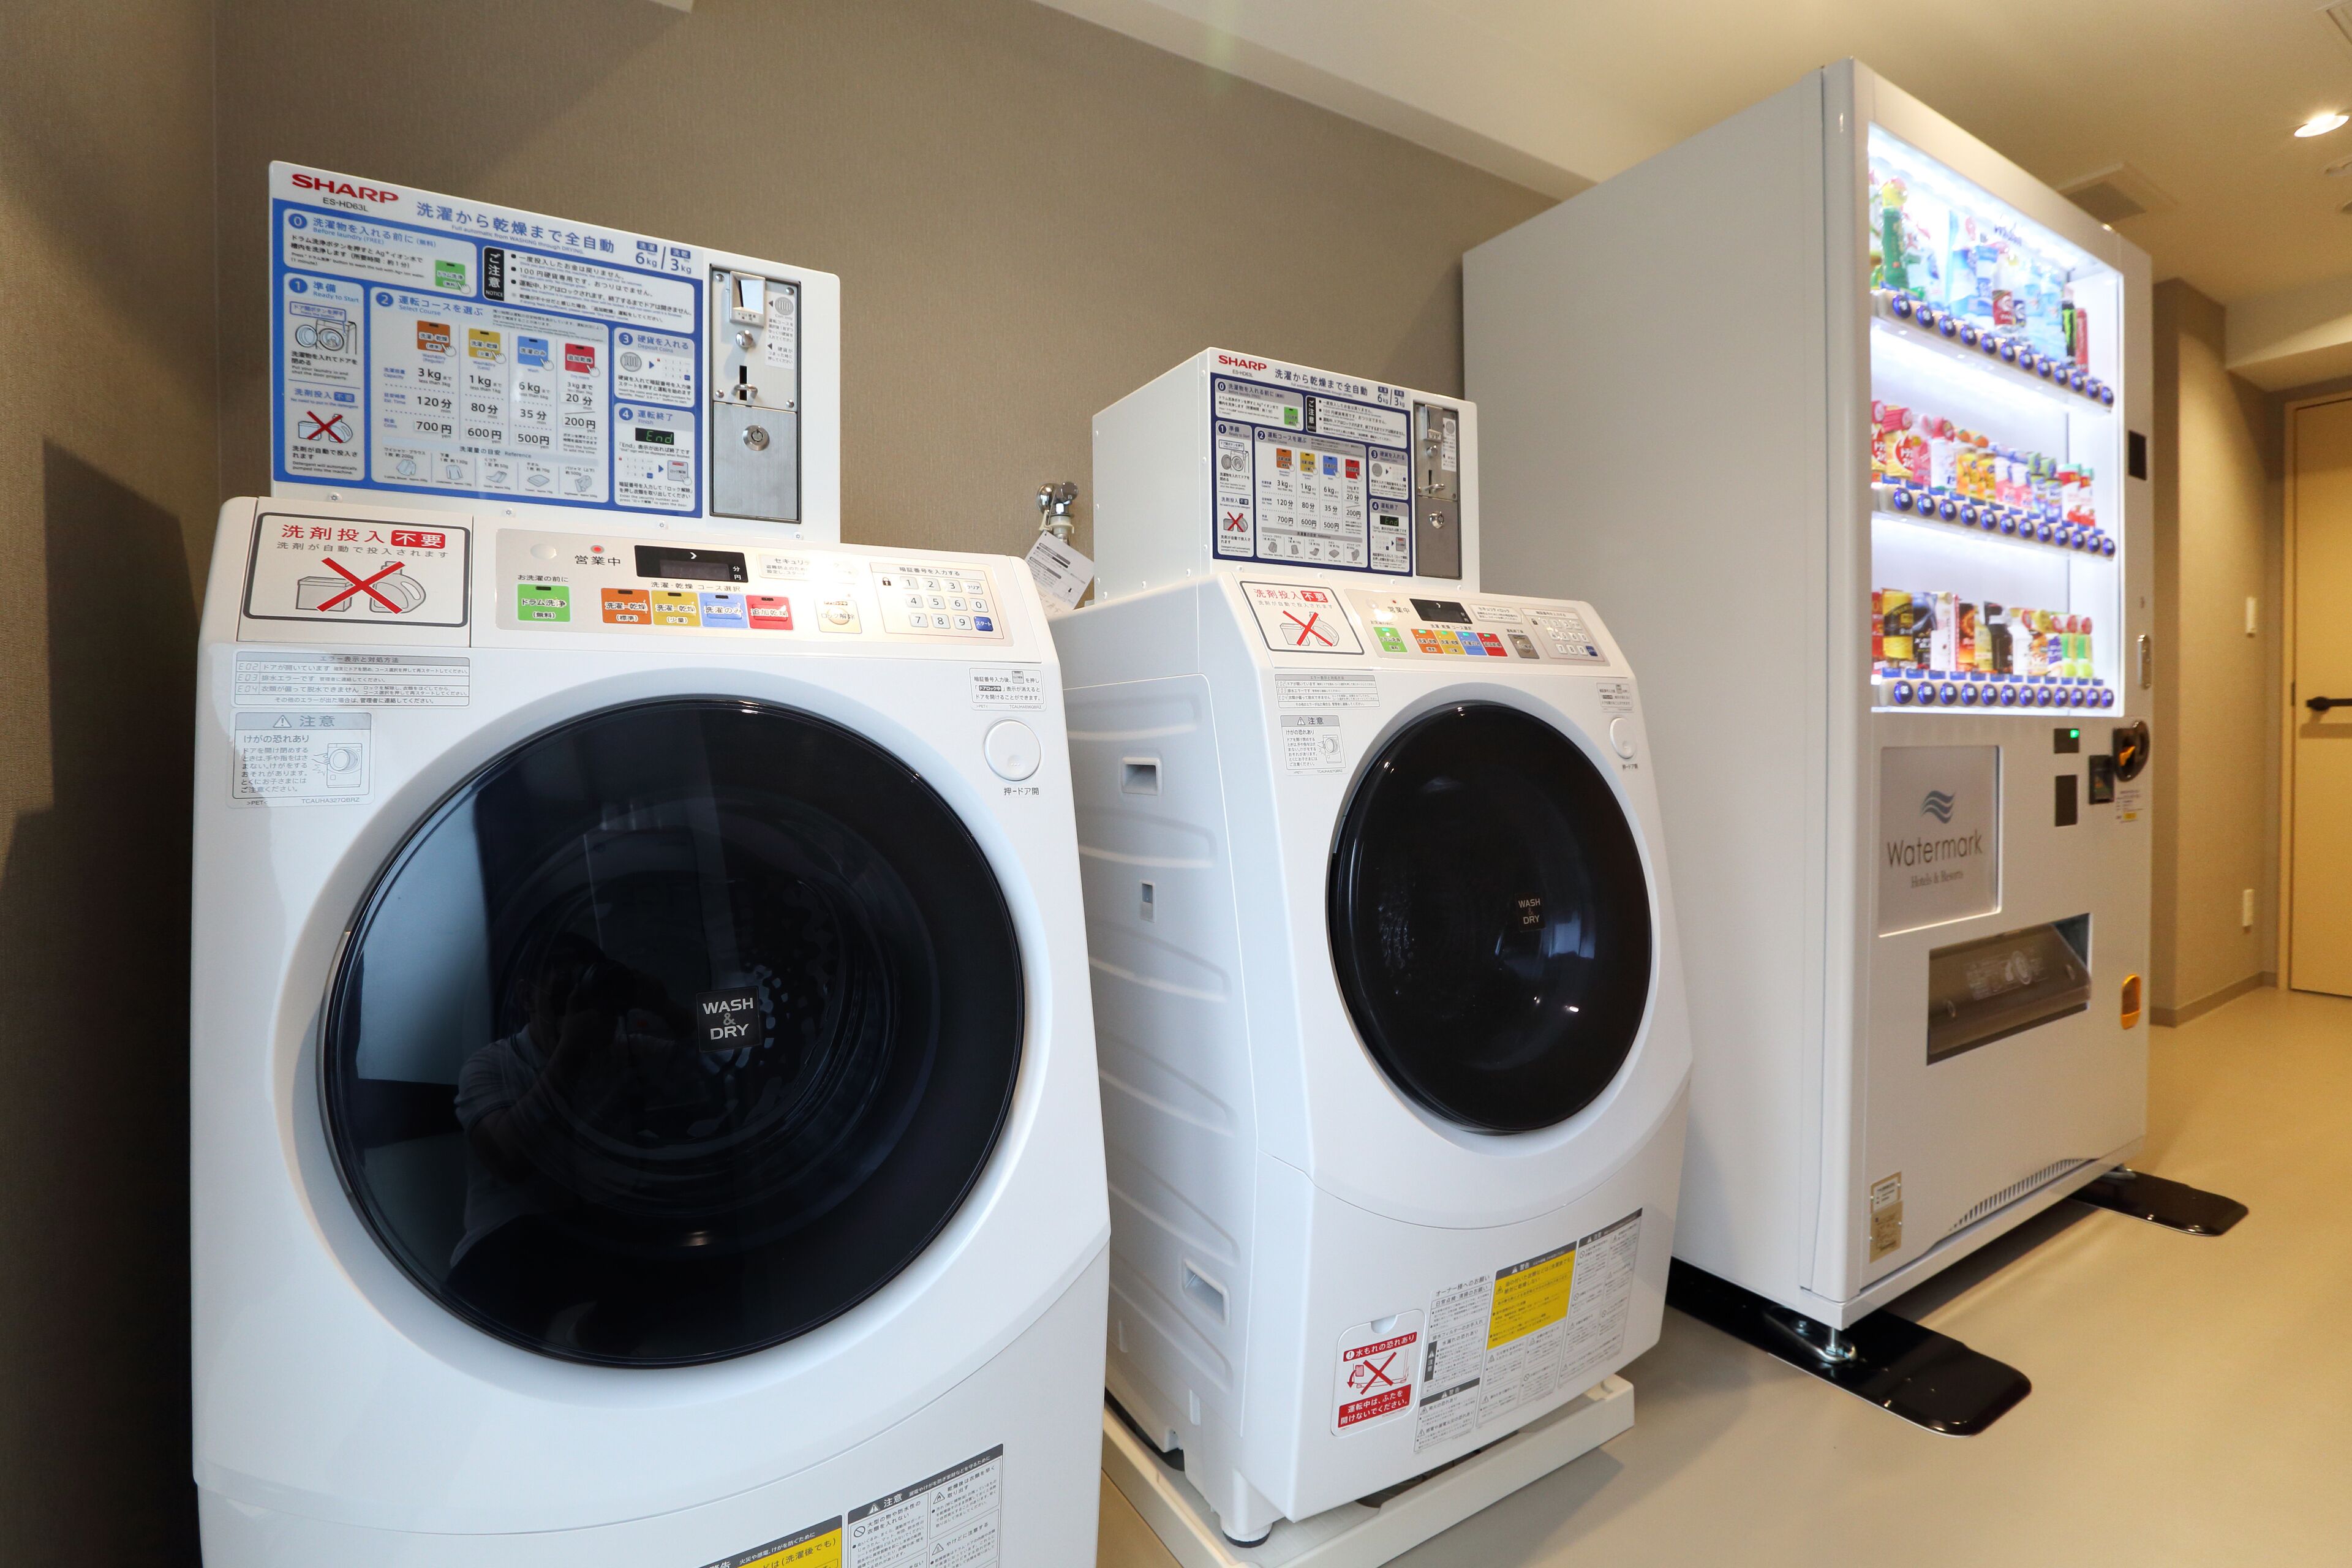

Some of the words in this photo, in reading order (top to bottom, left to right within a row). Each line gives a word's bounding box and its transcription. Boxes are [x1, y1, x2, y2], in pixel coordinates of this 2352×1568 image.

[292, 173, 399, 203] SHARP
[323, 197, 369, 212] ES-HD63L
[313, 218, 414, 244] 洗濯物を入れる前に
[313, 227, 333, 236] Before
[334, 230, 362, 243] laundry
[417, 201, 614, 254] 洗濯から乾燥まで全自動
[488, 254, 500, 288] ご注意
[313, 281, 336, 293] 準備
[313, 291, 334, 300] Ready
[399, 295, 483, 317] 運転コースを選ぶ
[399, 305, 417, 314] Select
[637, 334, 688, 350] 硬貨を入れる
[1219, 355, 1267, 371] SHARP
[1275, 369, 1368, 396] 洗濯から乾燥まで全自動
[637, 410, 673, 421] 運転終了
[646, 431, 673, 444] End
[281, 524, 385, 544] 洗剤投入
[394, 532, 442, 548] 不要
[277, 541, 449, 559] 洗剤が自動で投入されます
[575, 556, 621, 567] 営業中
[899, 567, 960, 576] 暗証番号を入力する
[1254, 588, 1302, 600] 洗剤投入
[1304, 592, 1327, 601] 不要
[521, 598, 566, 608] ドラム洗浄
[1258, 600, 1333, 609] 洗剤が自動で投入されます
[300, 715, 336, 727] 注意
[243, 735, 309, 744] けがの恐れあり
[1887, 829, 1983, 867] Watermark
[1518, 898, 1540, 908] WASH
[1523, 915, 1540, 924] DRY
[703, 997, 753, 1014] WASH
[723, 1012, 736, 1025] &
[710, 1023, 749, 1040] DRY
[1355, 1335, 1414, 1357] 水もれの恐れあり
[1348, 1390, 1403, 1413] 運転中は、ふたを
[1341, 1400, 1408, 1425] 開けないでください。
[948, 1485, 968, 1498] 取り出す
[883, 1493, 903, 1509] 注意
[867, 1501, 921, 1528] 大型の物や防水性の
[867, 1513, 910, 1534] 衣類を入れない
[946, 1523, 989, 1546] やけどに注意する
[739, 1532, 815, 1566] 火災や感電、けがを防ぐために
